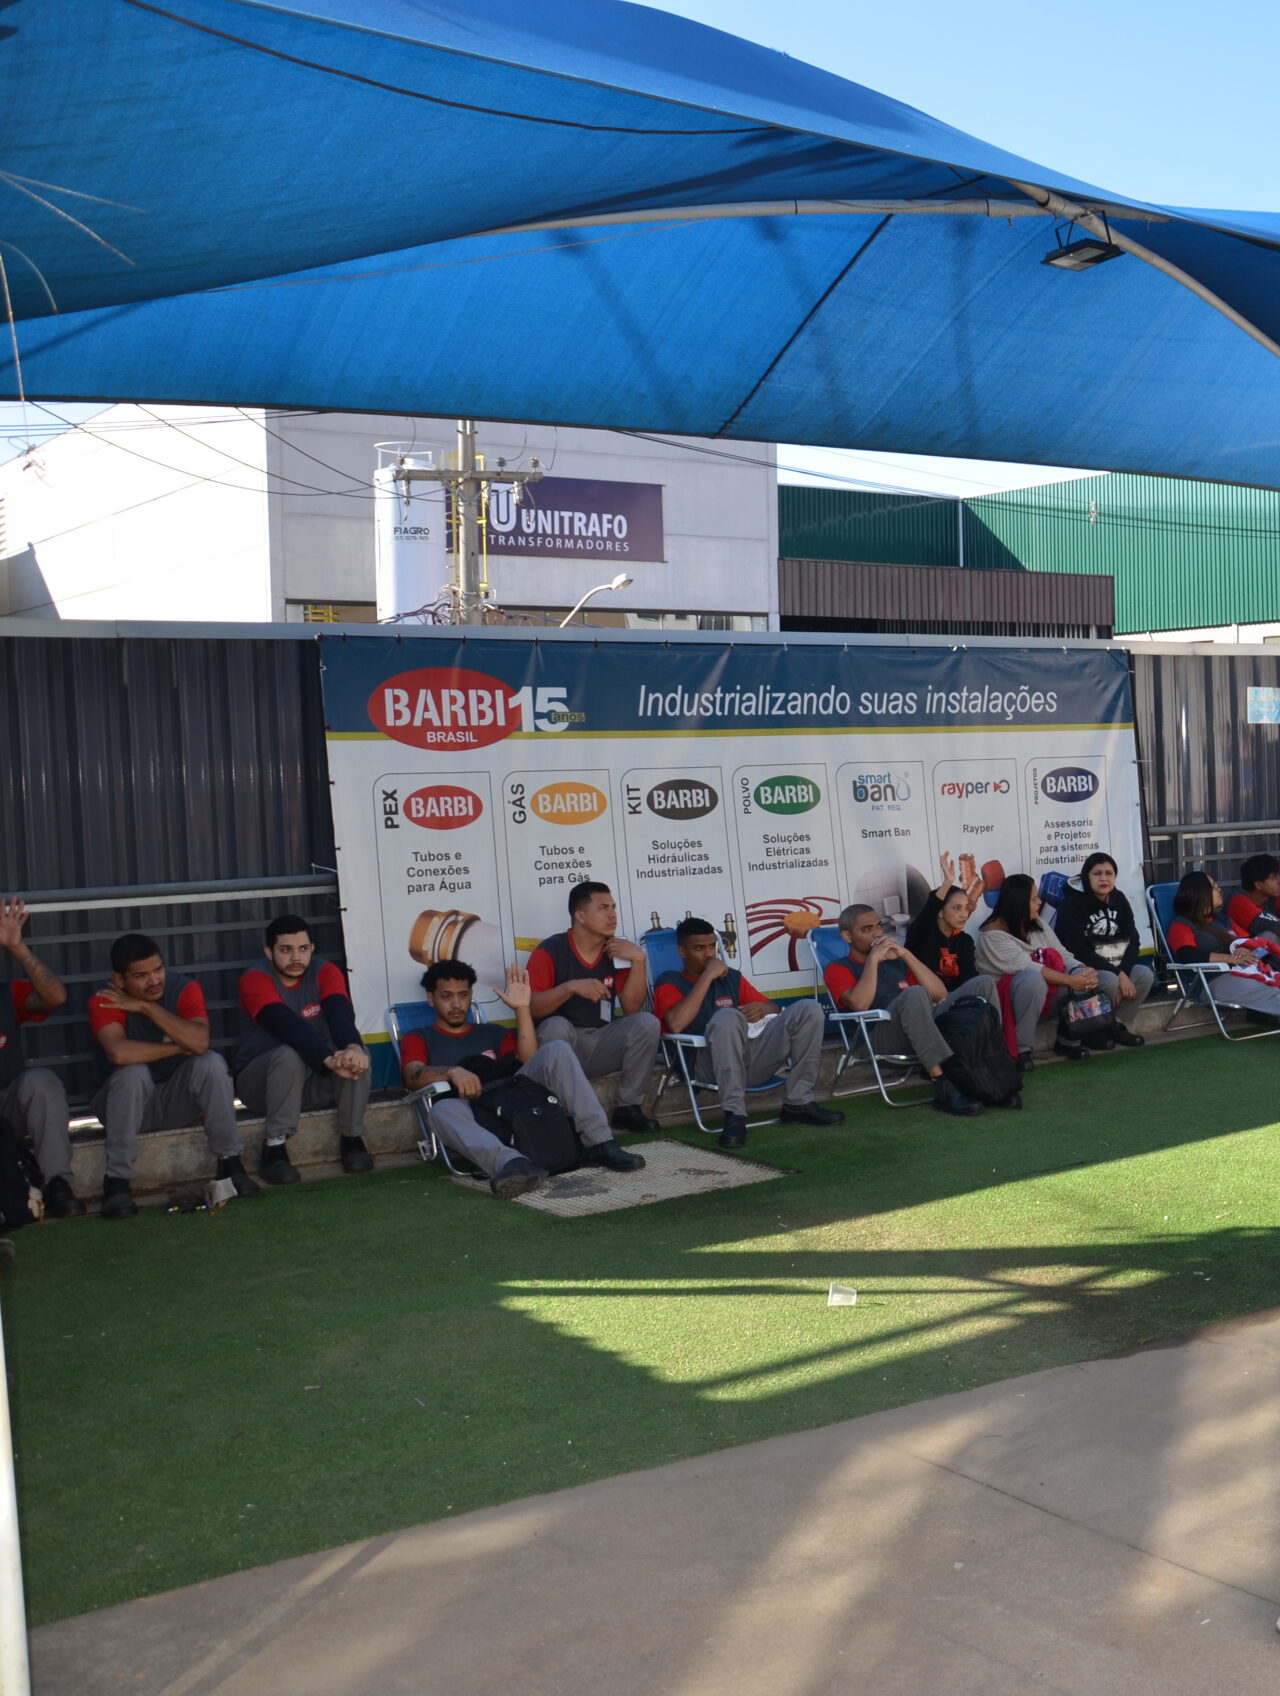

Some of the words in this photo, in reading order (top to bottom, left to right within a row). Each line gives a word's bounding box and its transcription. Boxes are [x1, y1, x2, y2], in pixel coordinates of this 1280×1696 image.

[393, 526, 430, 535] FIAGRO
[521, 509, 628, 539] UNITRAFO
[488, 534, 630, 552] TRANSFORMADORES
[638, 685, 851, 717] Industrializando
[858, 691, 918, 715] suas
[925, 684, 1058, 720] instalações
[384, 688, 506, 727] BARBI
[508, 686, 569, 732] 15
[552, 712, 585, 722] anos
[427, 732, 478, 743] BRASIL
[858, 772, 892, 784] smart
[1046, 775, 1093, 793] BARBI
[741, 777, 752, 815] POLVO
[760, 784, 814, 805] BARBI
[852, 780, 896, 803] ban
[941, 781, 990, 798] rayper
[508, 783, 527, 824] GÁS
[538, 792, 599, 814] BARBI
[626, 784, 642, 814] KIT
[652, 788, 711, 810] BARBI
[382, 789, 400, 829] PEX
[411, 796, 474, 818] BARBI
[963, 824, 995, 835] Rayper
[1044, 818, 1093, 829] Assessoria
[762, 833, 811, 844] Soluções
[861, 828, 892, 838] Smart
[893, 827, 911, 837] Ban
[1054, 831, 1091, 841] Projetos
[539, 845, 575, 856] Tubos
[578, 846, 585, 854] e
[651, 839, 703, 851] Soluções
[765, 846, 811, 857] Elétricas
[1039, 845, 1058, 855] para
[1061, 842, 1099, 852] sistemas
[412, 851, 451, 862] Tubos
[454, 852, 462, 860] e
[647, 852, 710, 865] Hidráulicas
[1035, 854, 1086, 865] industrializ
[534, 859, 592, 871] Conexões
[748, 858, 829, 871] Industrializadas
[406, 865, 470, 878] Conexões
[636, 864, 723, 879] Industrializadas
[538, 875, 565, 887] para
[567, 872, 591, 883] Gás
[407, 883, 435, 895] para
[439, 878, 472, 893] Água
